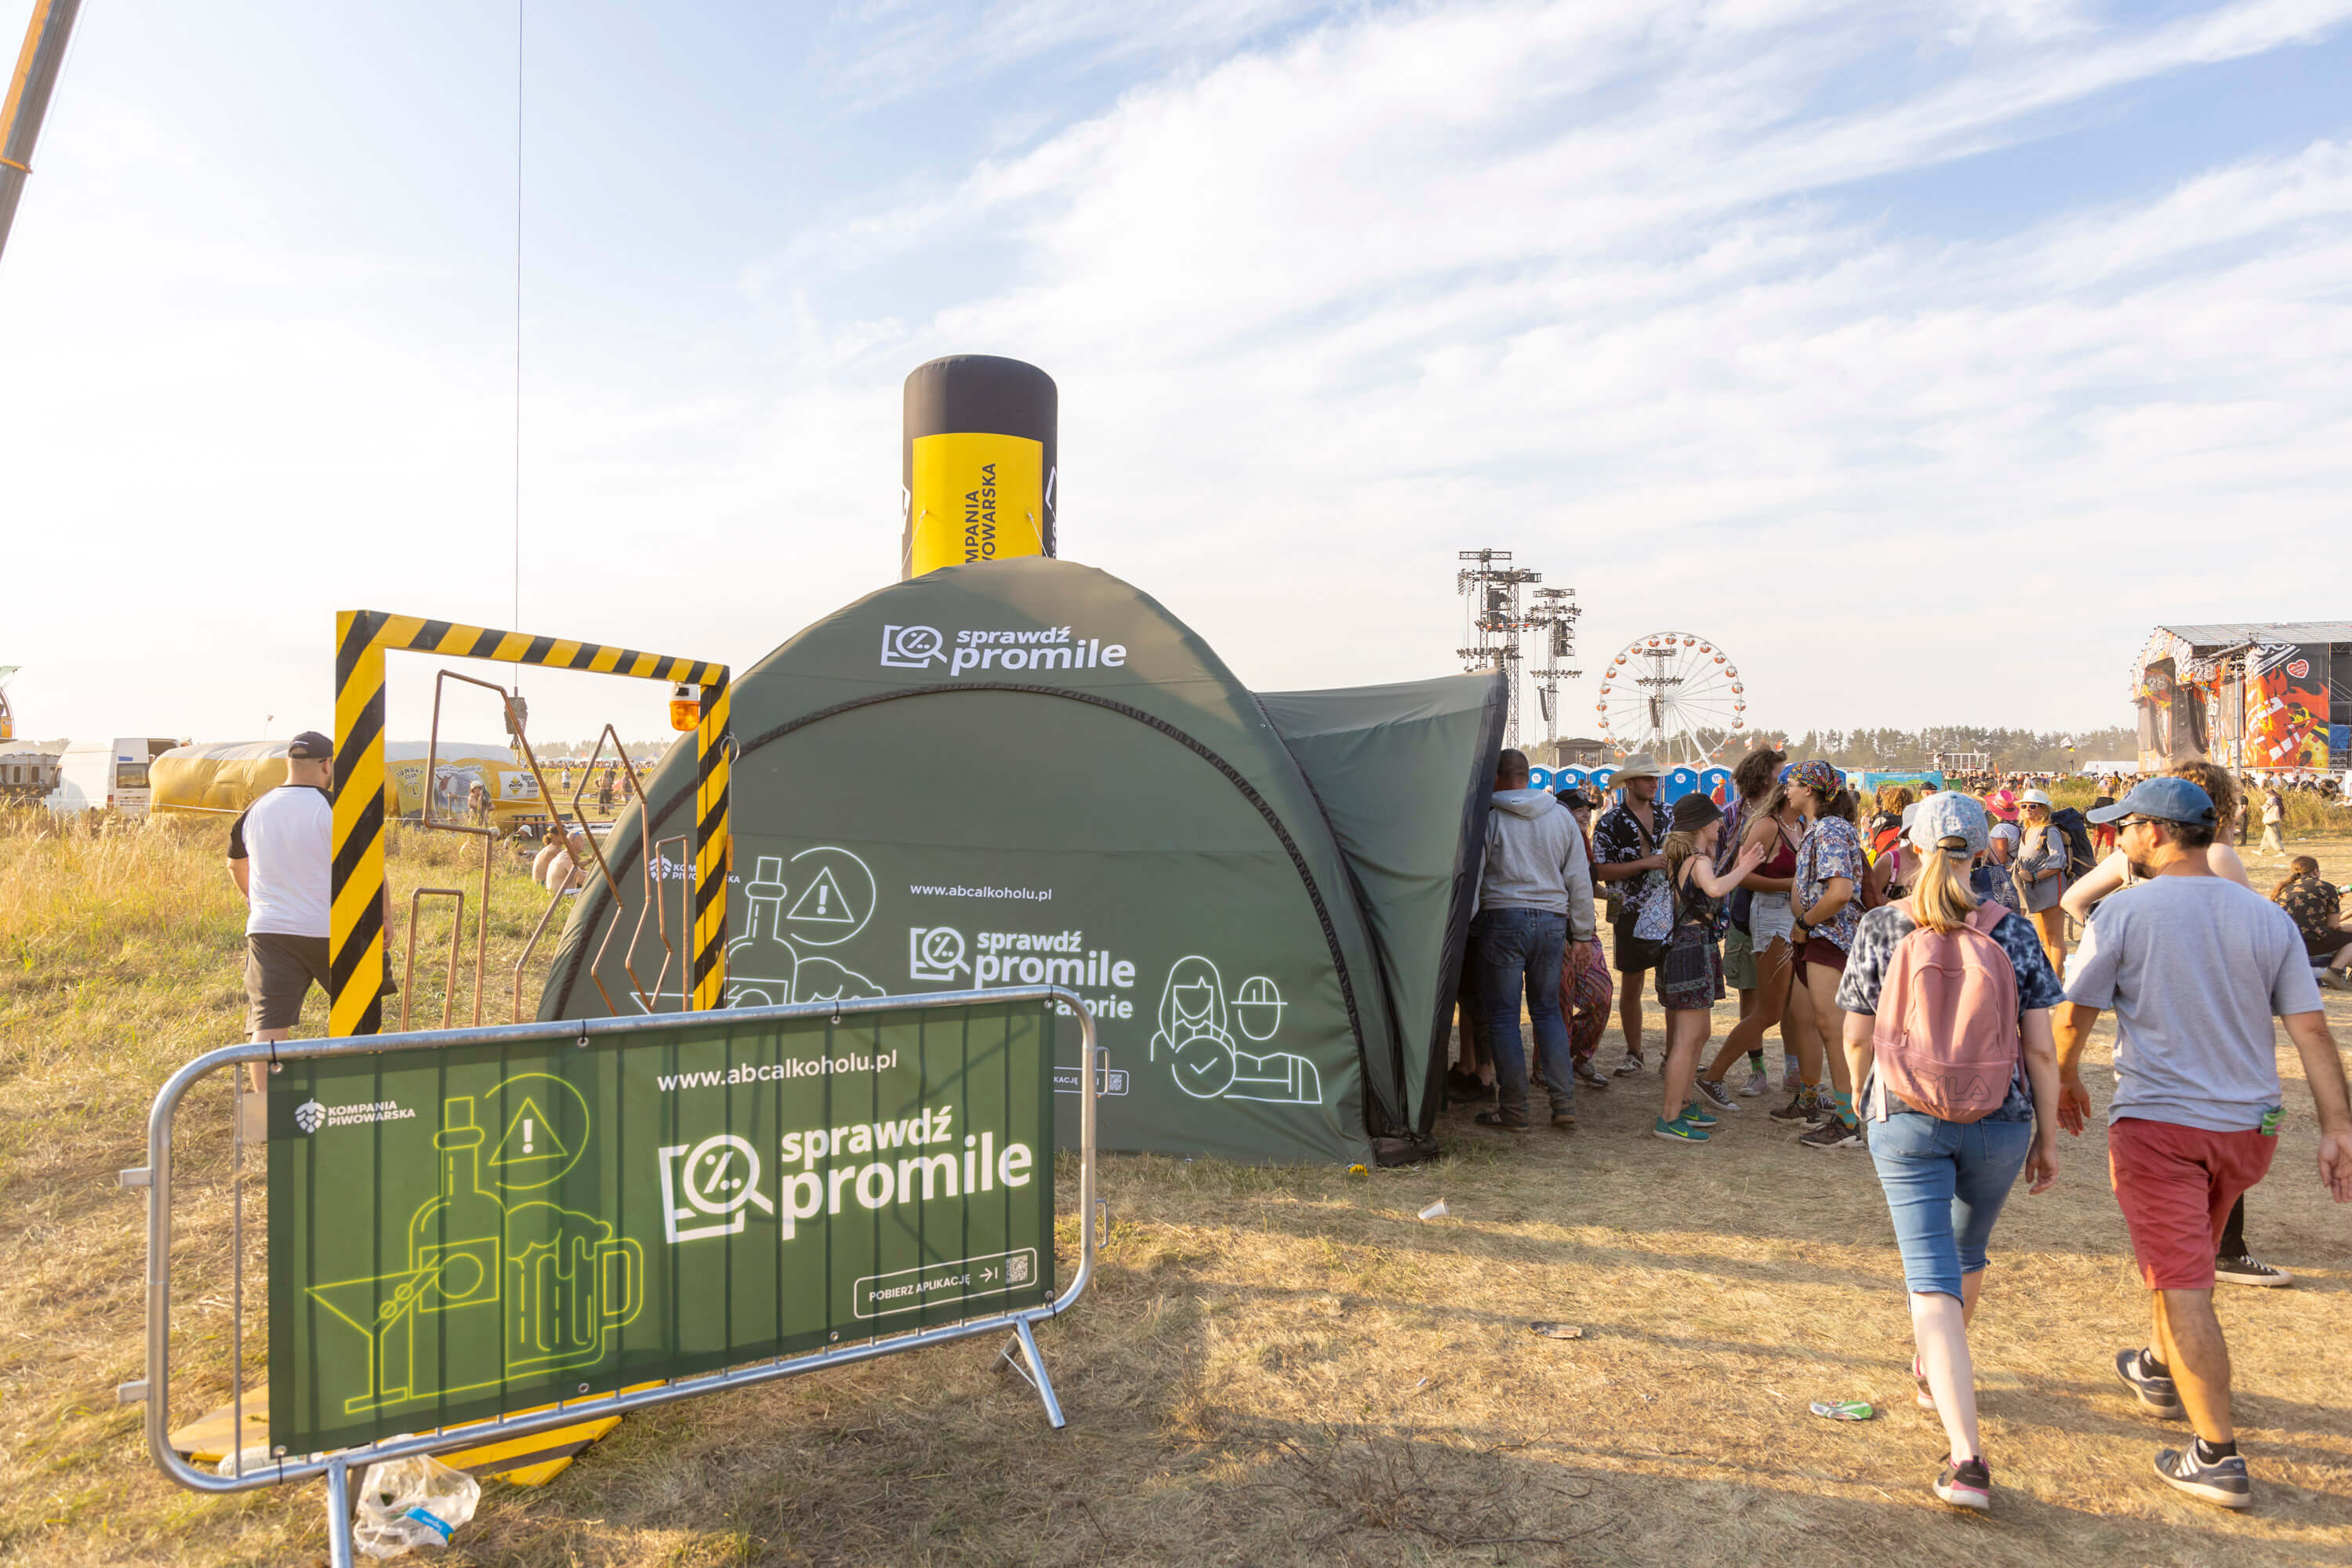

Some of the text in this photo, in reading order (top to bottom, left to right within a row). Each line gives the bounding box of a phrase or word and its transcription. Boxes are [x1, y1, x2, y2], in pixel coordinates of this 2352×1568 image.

[965, 490, 980, 564] MPANIA
[982, 463, 996, 561] OWARSKA
[956, 626, 1072, 648] sprawdź
[950, 639, 1127, 677] promile
[910, 884, 1052, 902] www.abcalkoholu.pl
[977, 931, 1082, 955] sprawdź
[975, 950, 1135, 990] promile
[657, 1049, 897, 1091] www.abcalkoholu.pl
[1911, 1067, 1991, 1102] FILA
[327, 1100, 397, 1116] KOMPANIA
[328, 1108, 416, 1127] PIWOWARSKA
[782, 1105, 953, 1171] sprawdź
[782, 1131, 1033, 1241] promile
[869, 1273, 971, 1302] POBIERZ APLIKACJĘ
